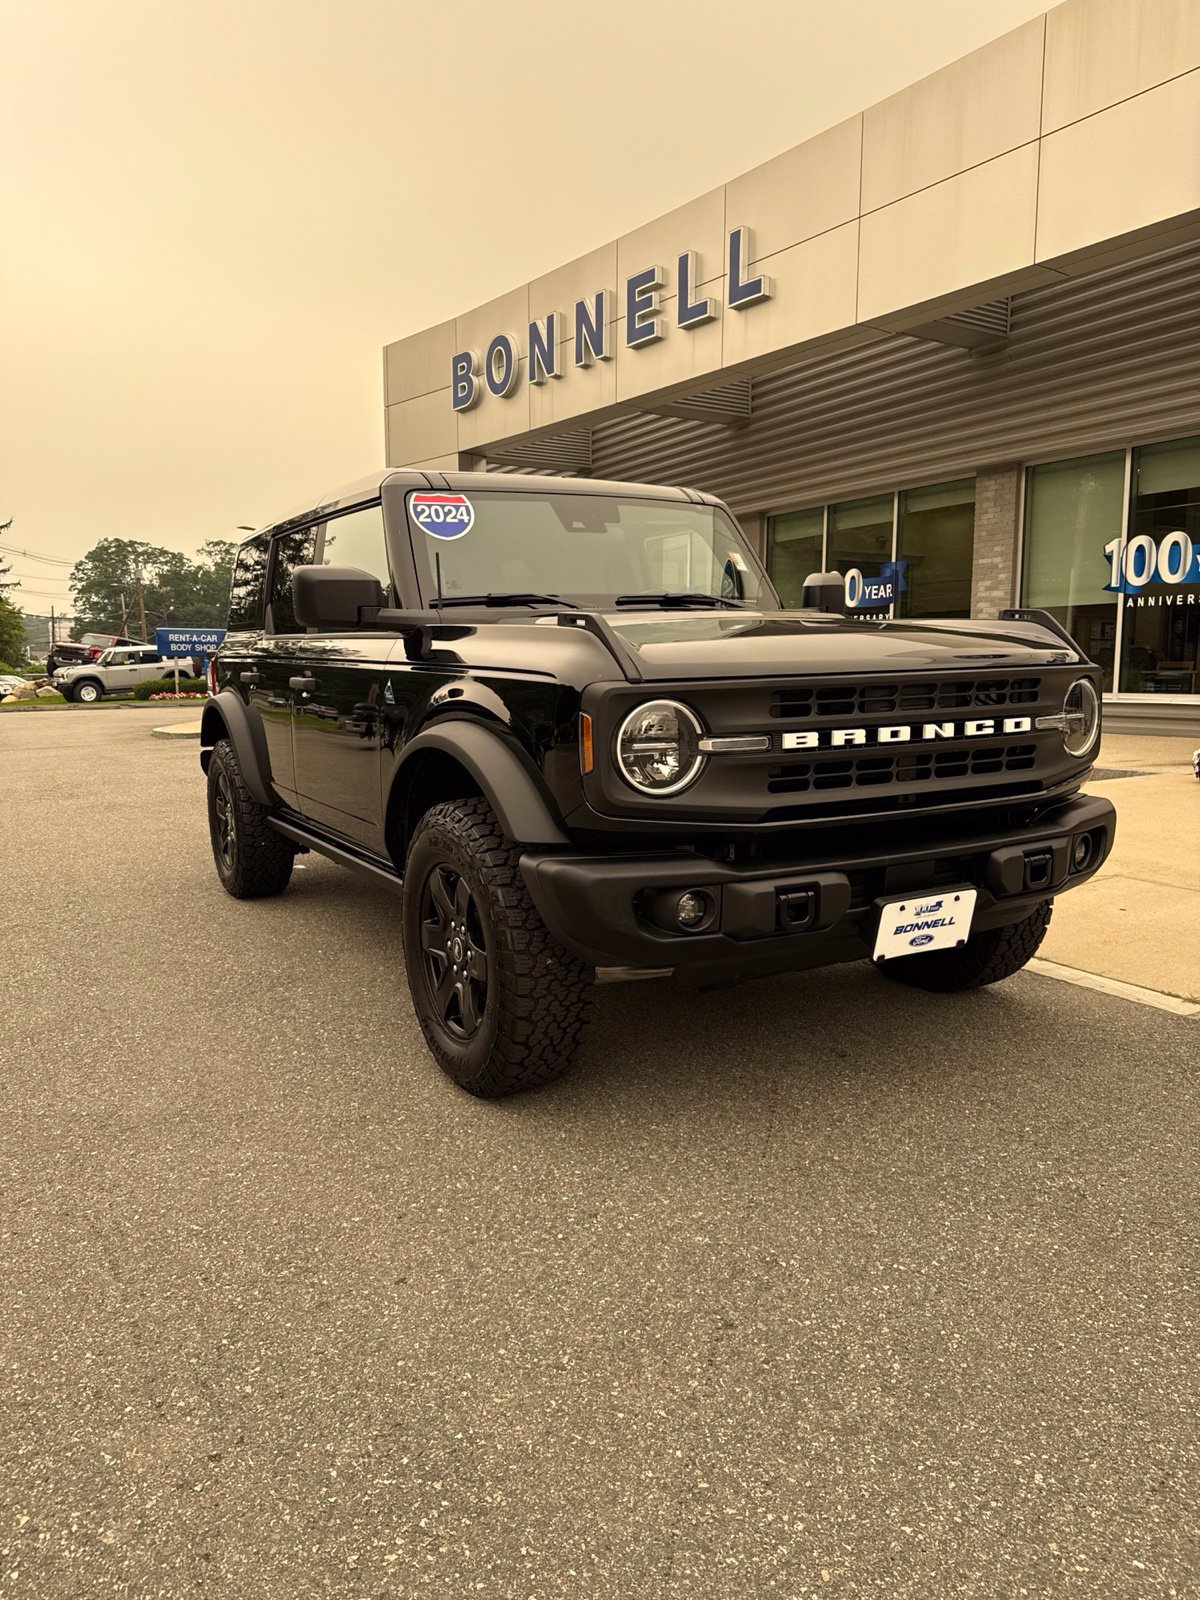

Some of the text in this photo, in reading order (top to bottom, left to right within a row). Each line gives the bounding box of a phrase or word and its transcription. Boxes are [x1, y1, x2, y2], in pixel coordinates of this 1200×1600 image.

[451, 225, 771, 412] BONNELL
[416, 504, 470, 523] 2024
[1104, 530, 1193, 588] 100
[864, 584, 893, 599] YEAR
[1126, 593, 1200, 608] ANNIVER
[169, 634, 217, 642] RENT-A-CAR
[171, 643, 192, 651] BODY
[781, 716, 1032, 750] BRONCO
[893, 917, 955, 935] BONNELL
